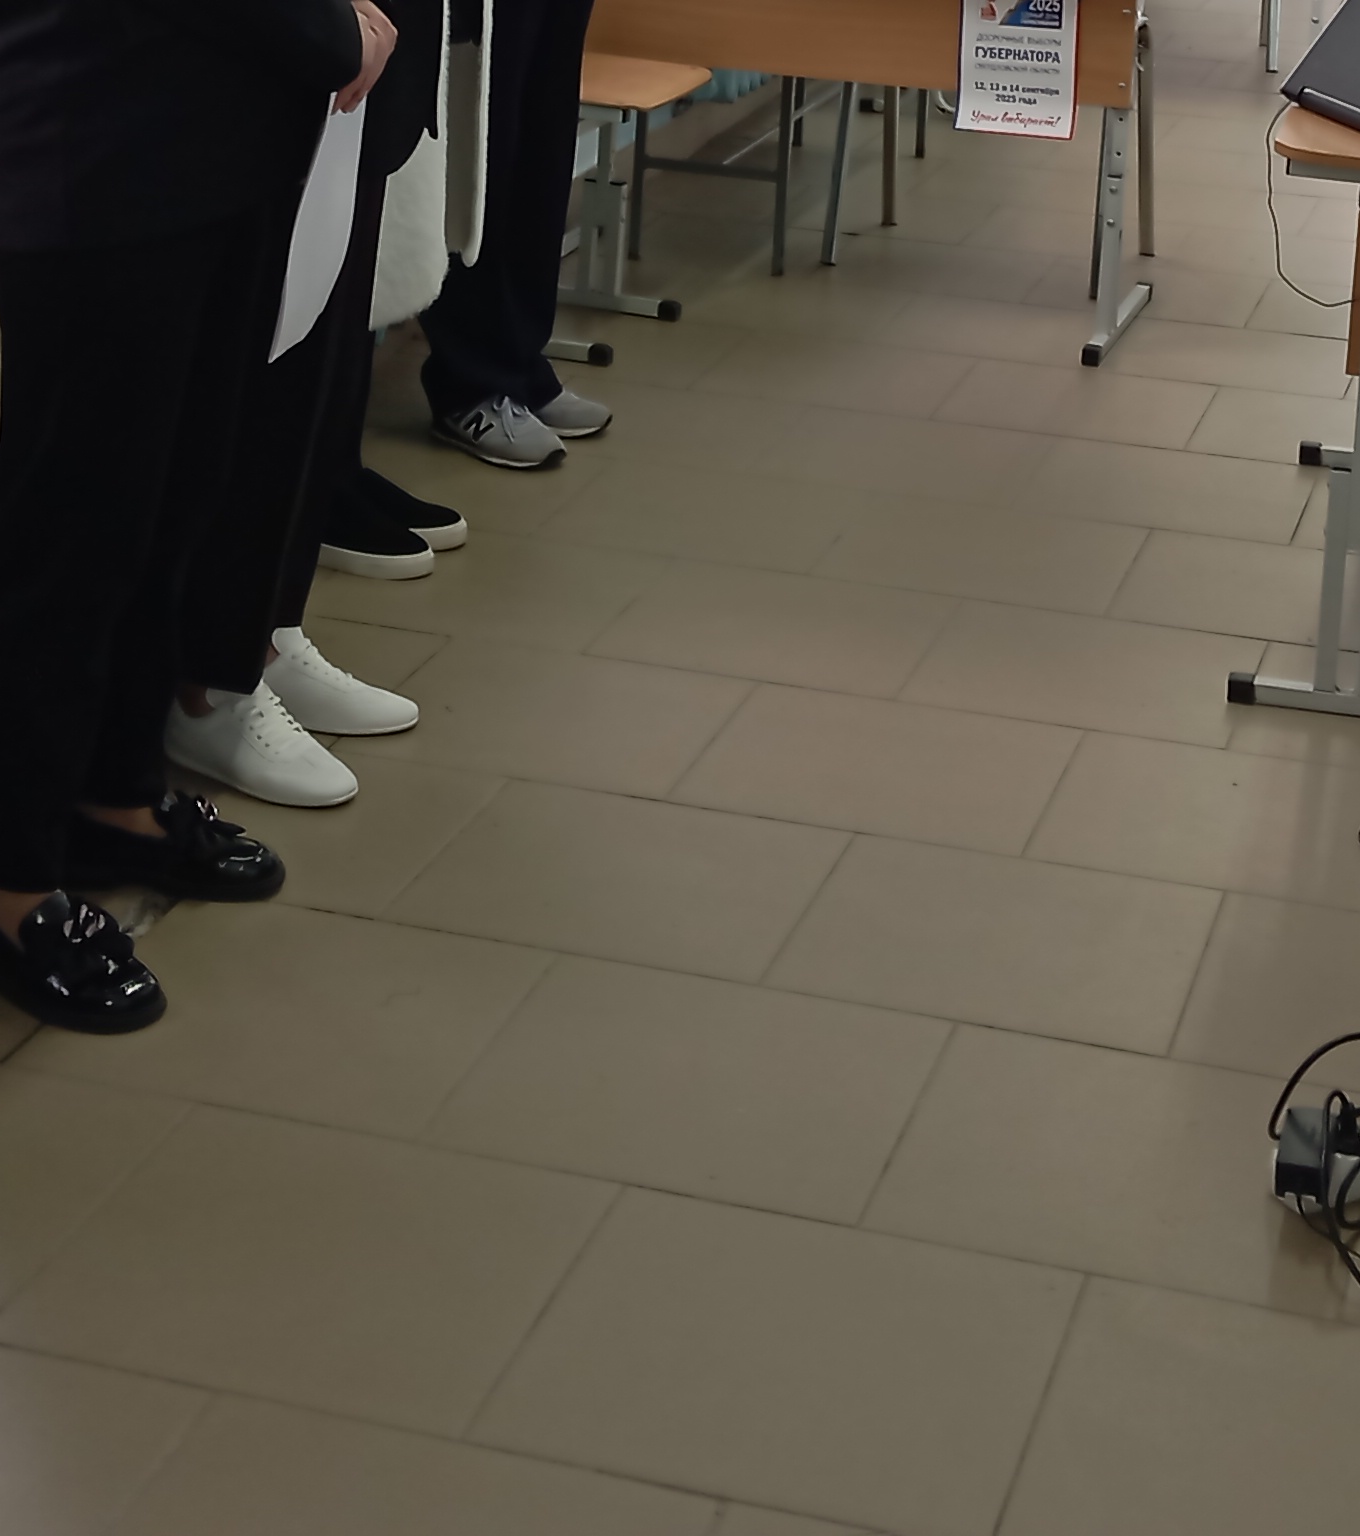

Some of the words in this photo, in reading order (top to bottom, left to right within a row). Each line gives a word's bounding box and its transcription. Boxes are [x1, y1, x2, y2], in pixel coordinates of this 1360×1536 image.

[974, 45, 1061, 64] ГУБЕРНАТОРА
[1009, 84, 1020, 93] 14
[1018, 96, 1038, 106] года
[462, 410, 496, 443] N
